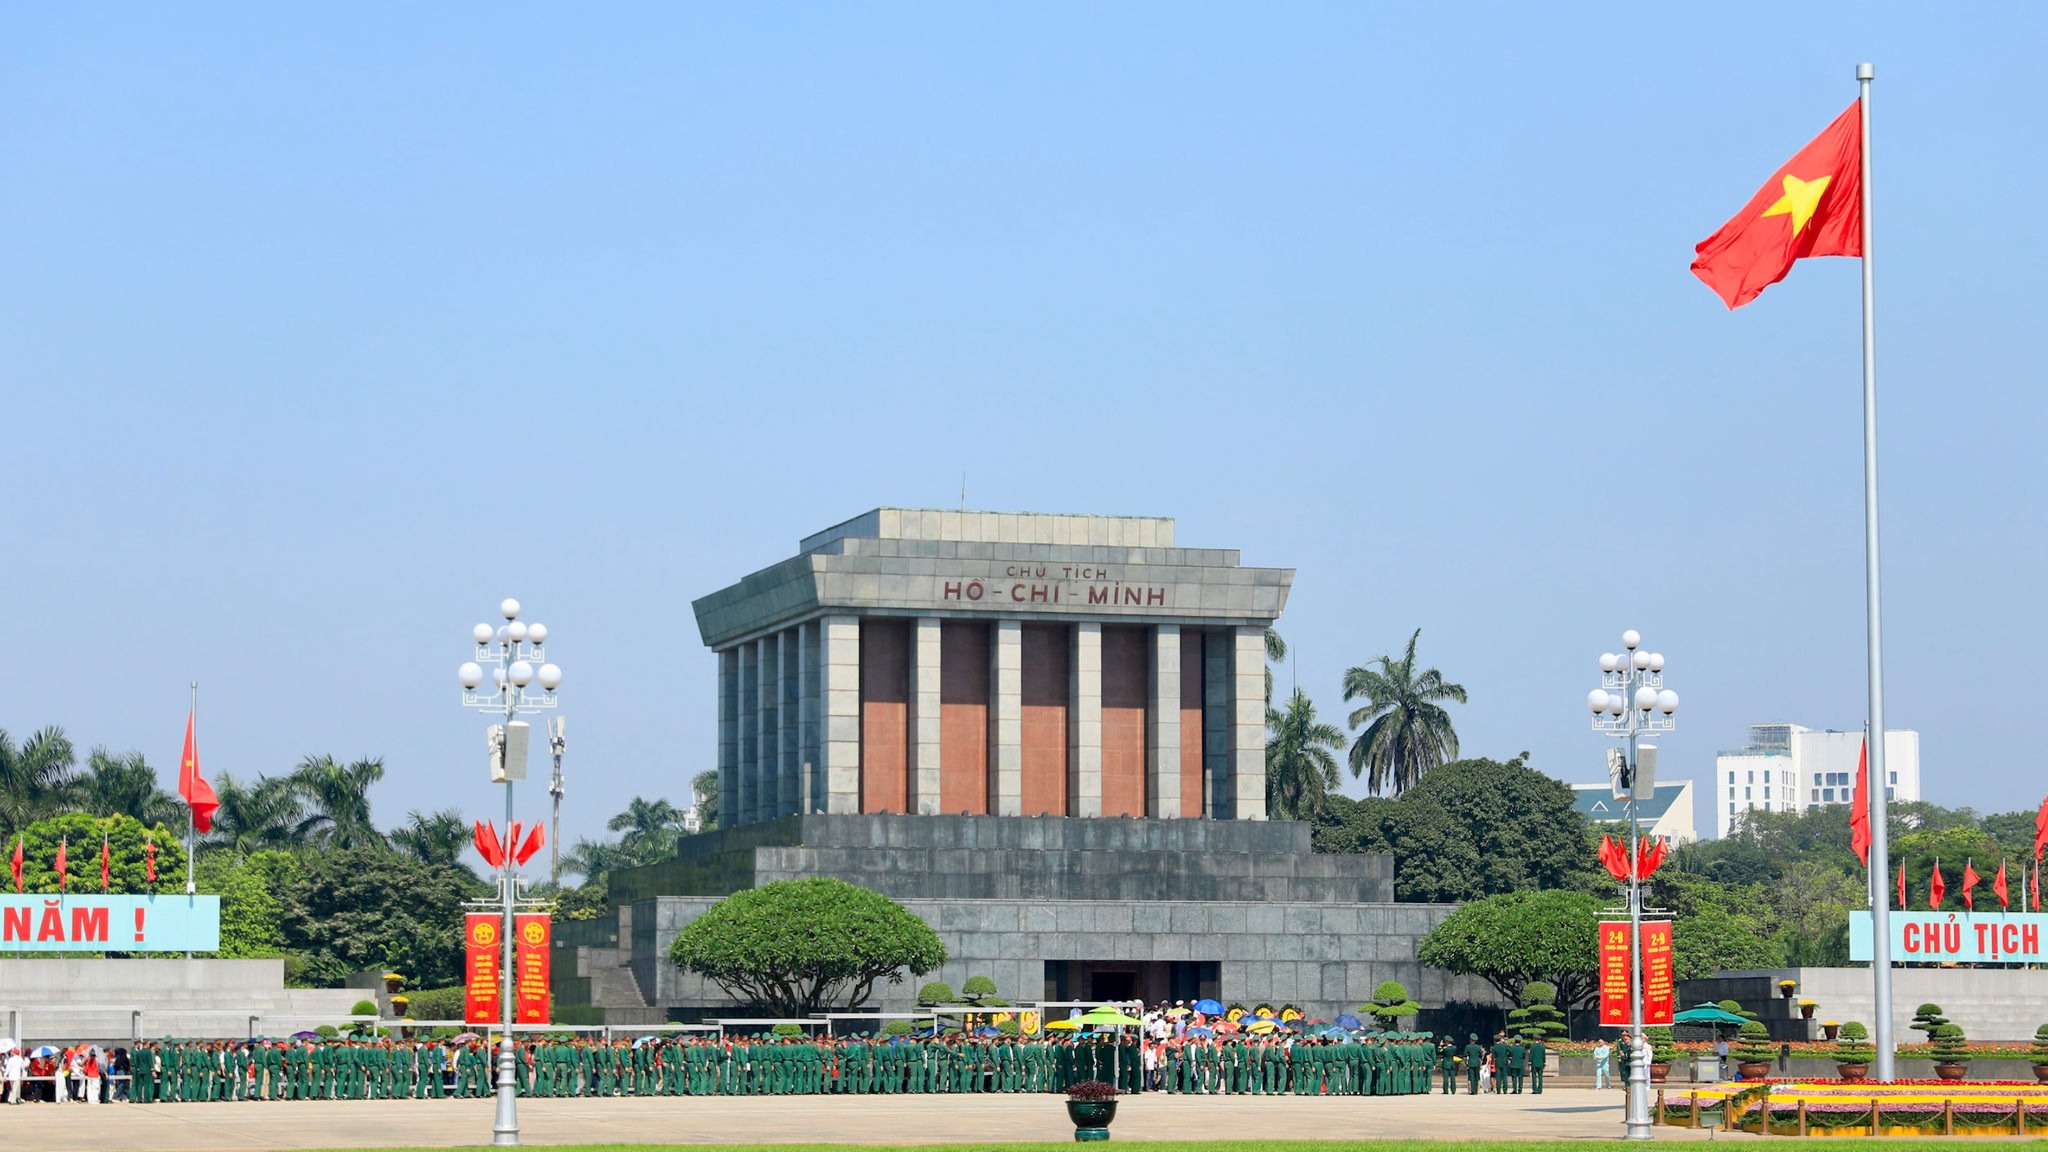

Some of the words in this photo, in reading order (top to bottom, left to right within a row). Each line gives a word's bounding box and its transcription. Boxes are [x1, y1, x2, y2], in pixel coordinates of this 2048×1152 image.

[943, 577, 986, 601] HỒ
[3, 899, 109, 942] NĂM
[1609, 931, 1624, 944] 2-9
[1651, 932, 1665, 946] 2-9
[1903, 913, 1961, 954] CHỦ
[1974, 923, 2039, 960] TỊCH
